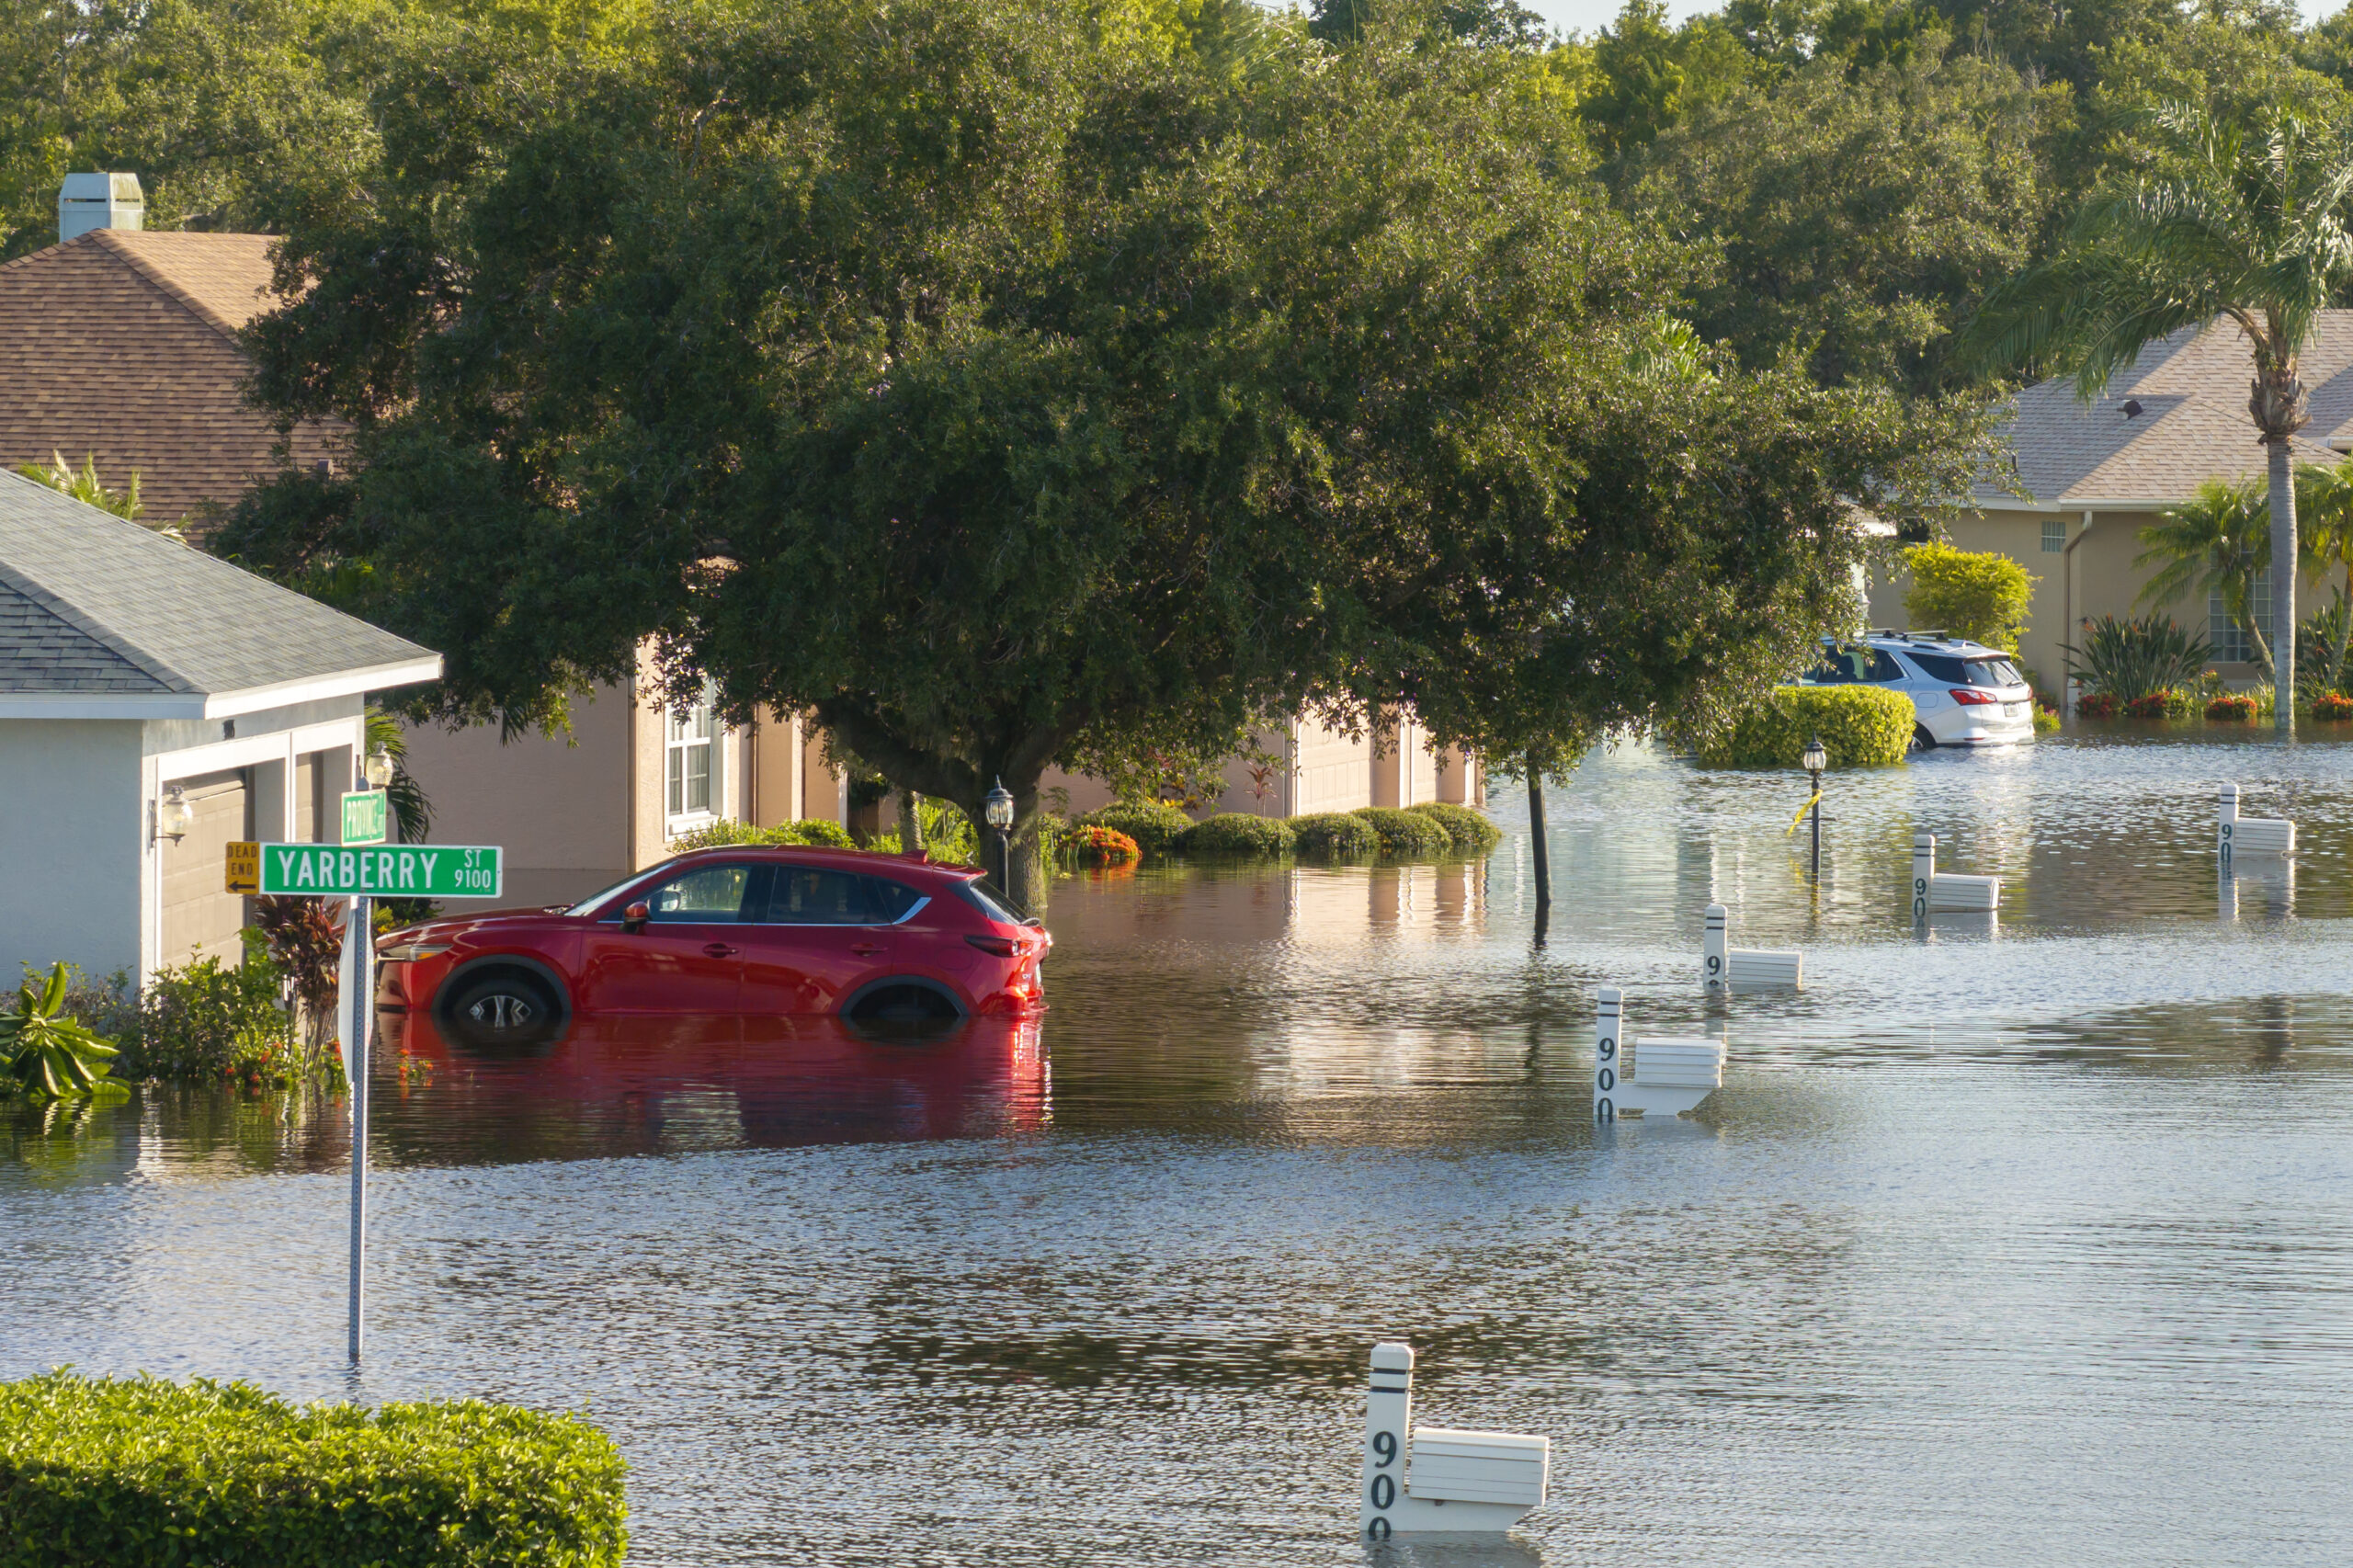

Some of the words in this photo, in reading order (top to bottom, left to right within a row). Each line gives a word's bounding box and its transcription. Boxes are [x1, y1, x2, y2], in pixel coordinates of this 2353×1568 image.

[227, 845, 257, 858] DEAD
[464, 848, 483, 869] ST
[232, 862, 253, 876] END
[278, 850, 438, 889] YARBERRY
[454, 869, 492, 889] 9100
